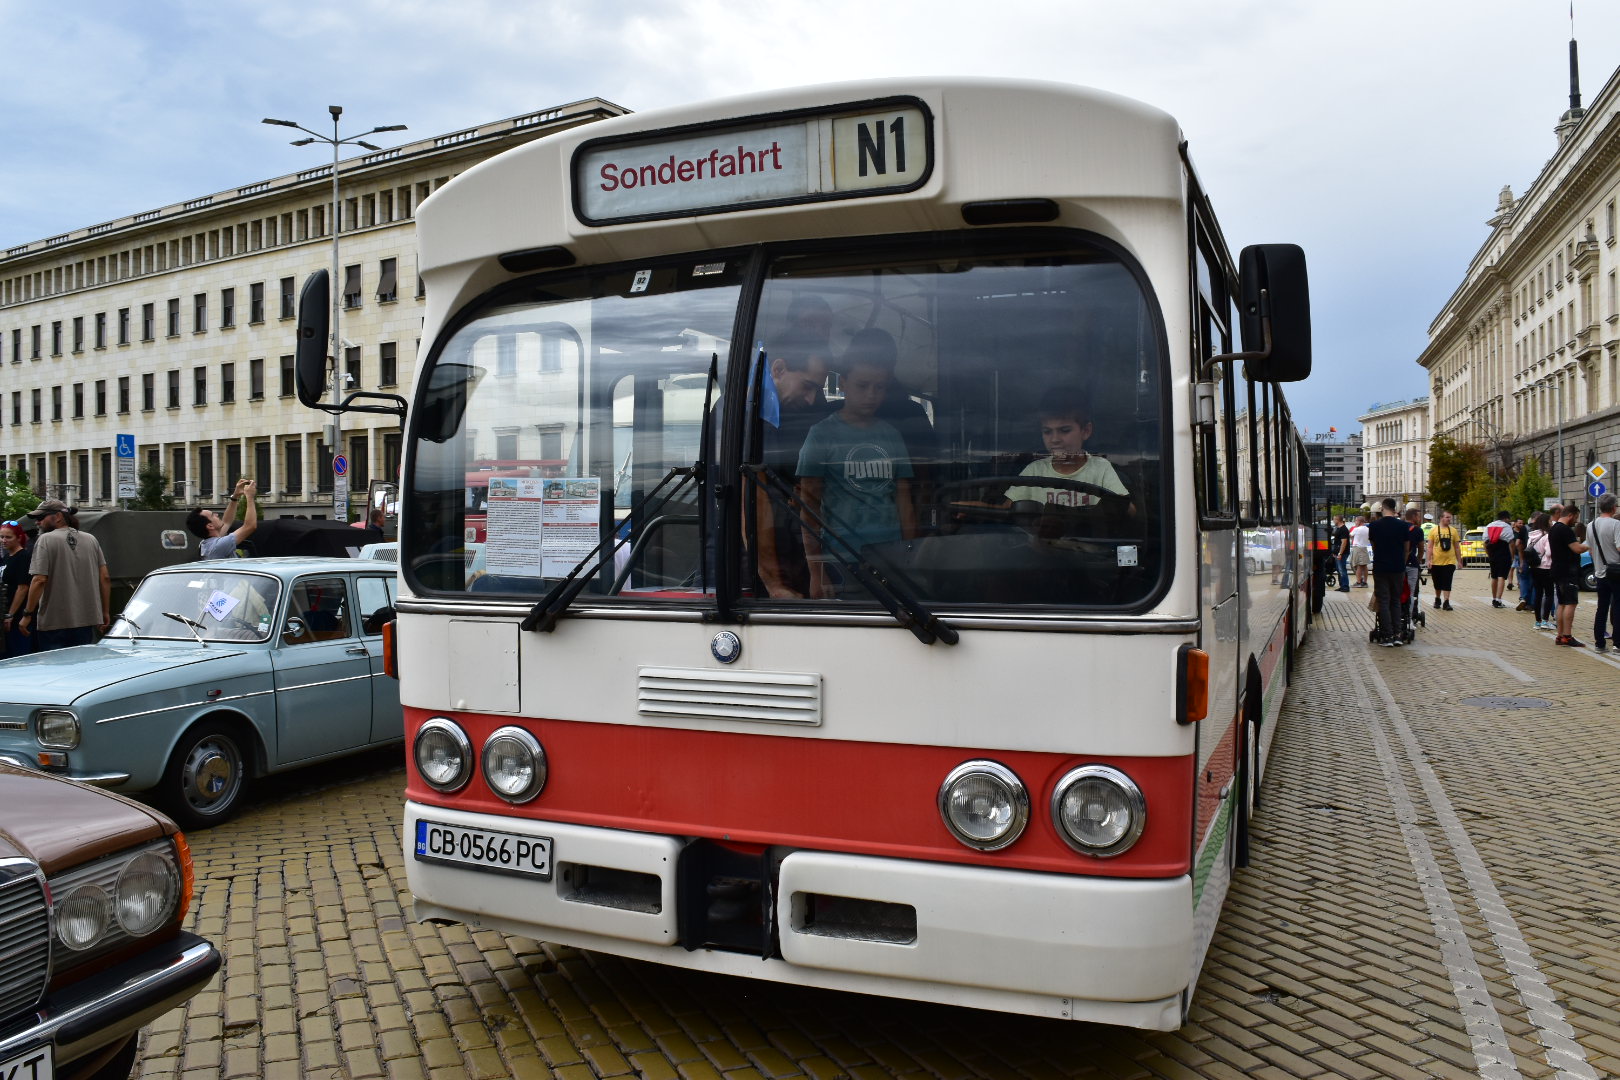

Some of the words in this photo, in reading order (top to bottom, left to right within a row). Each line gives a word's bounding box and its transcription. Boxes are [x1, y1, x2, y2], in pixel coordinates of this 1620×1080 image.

[600, 141, 783, 192] Sonderfahrt
[857, 115, 906, 177] N1
[843, 460, 893, 479] PUMA
[417, 842, 426, 851] BG
